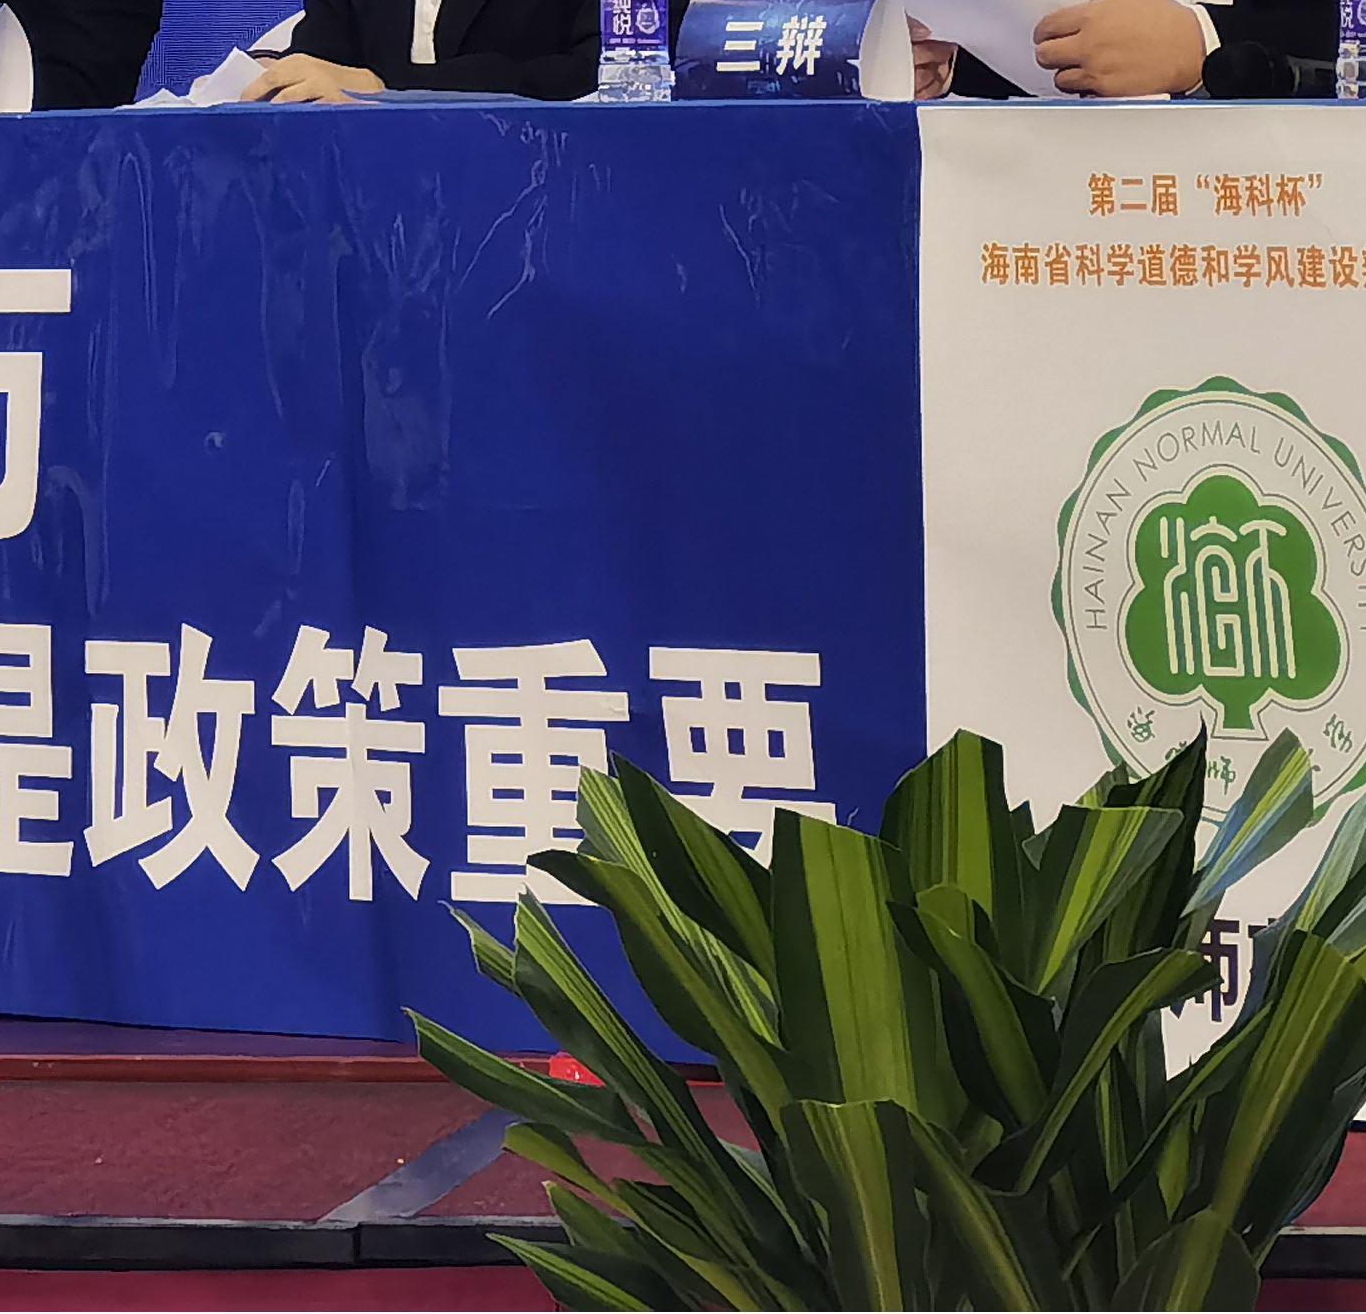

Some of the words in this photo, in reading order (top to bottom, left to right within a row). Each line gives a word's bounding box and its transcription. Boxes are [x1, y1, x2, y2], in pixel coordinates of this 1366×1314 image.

[716, 14, 828, 76] 三辩
[1087, 173, 1324, 217] 第二届“海科杯”
[1083, 477, 1133, 631] HAINAN
[1132, 419, 1262, 483] NORMAL
